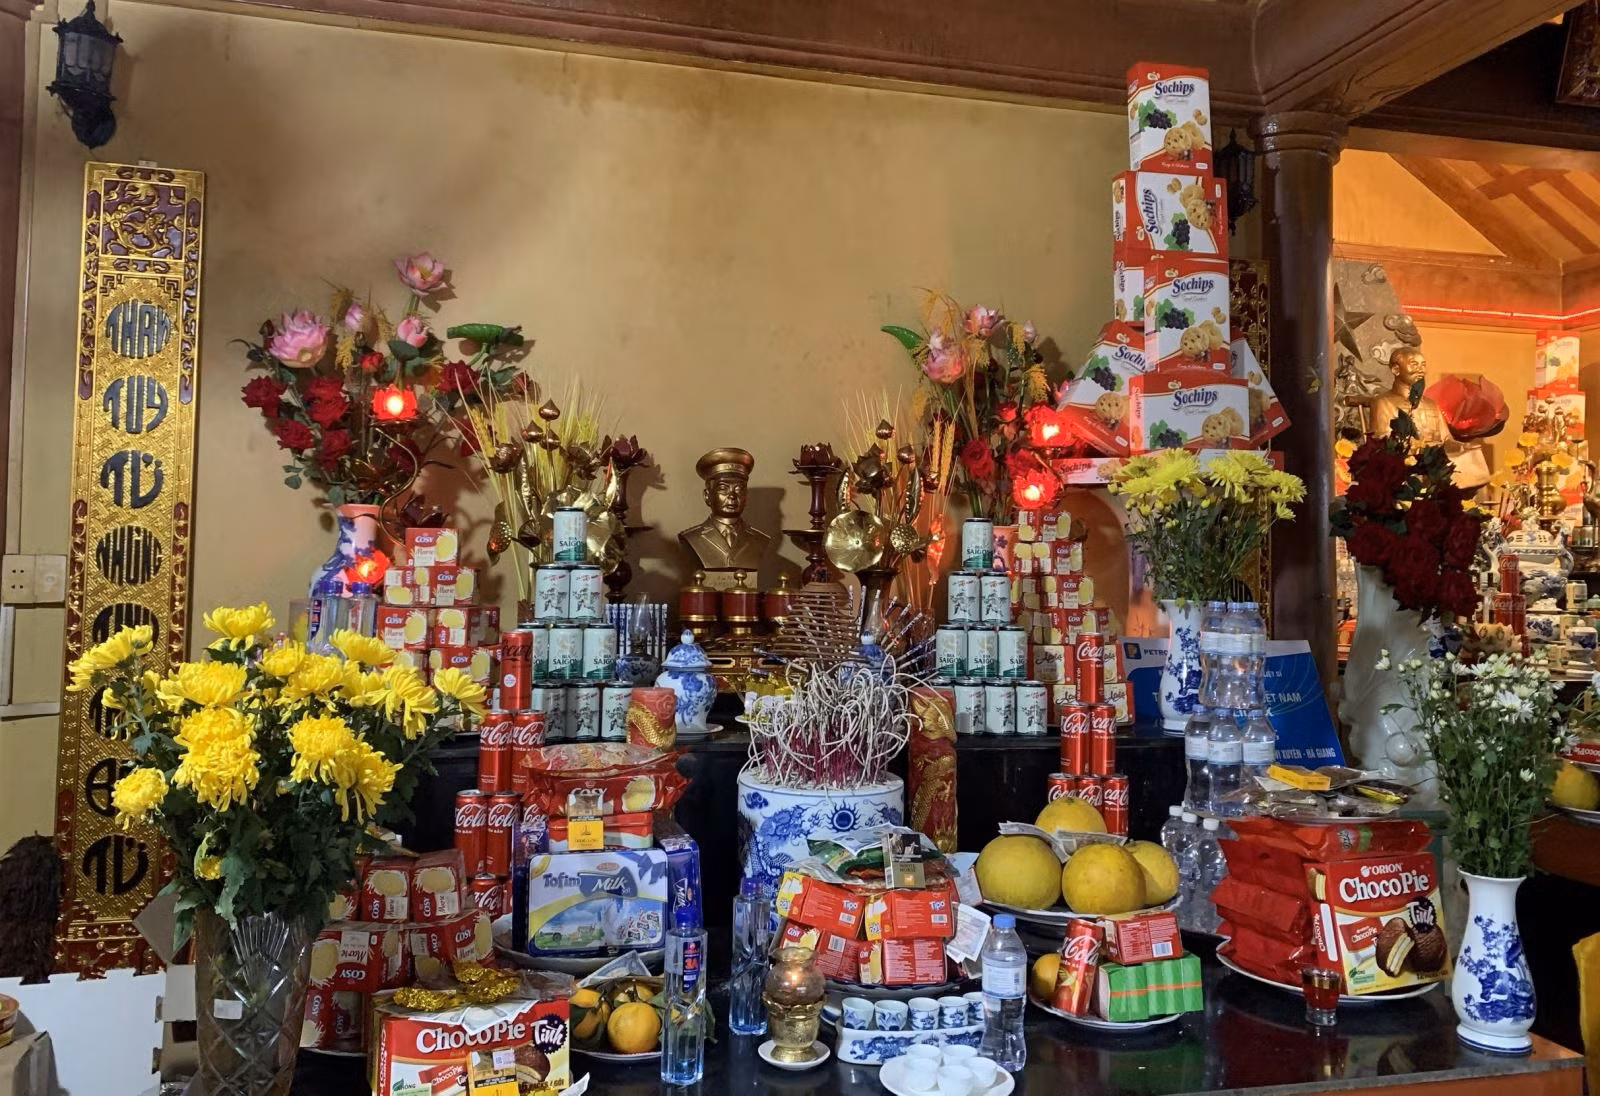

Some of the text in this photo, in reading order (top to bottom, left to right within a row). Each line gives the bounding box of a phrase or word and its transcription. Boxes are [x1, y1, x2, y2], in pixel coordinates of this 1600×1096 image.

[1155, 80, 1195, 96] Sochips
[1141, 188, 1159, 234] Sochips
[1172, 277, 1214, 294] Sochips
[1173, 388, 1218, 407] Sochips
[1280, 693, 1302, 703] NAM
[1316, 748, 1336, 758] GIANG
[1372, 863, 1402, 876] ORION
[592, 876, 627, 892] Milk
[1340, 870, 1430, 902] ChocoPie
[372, 898, 380, 918] COSY
[424, 898, 432, 917] COSY
[456, 929, 472, 942] COSY
[341, 949, 367, 962] Marie
[340, 970, 366, 980] COSY
[312, 996, 322, 1016] COSY
